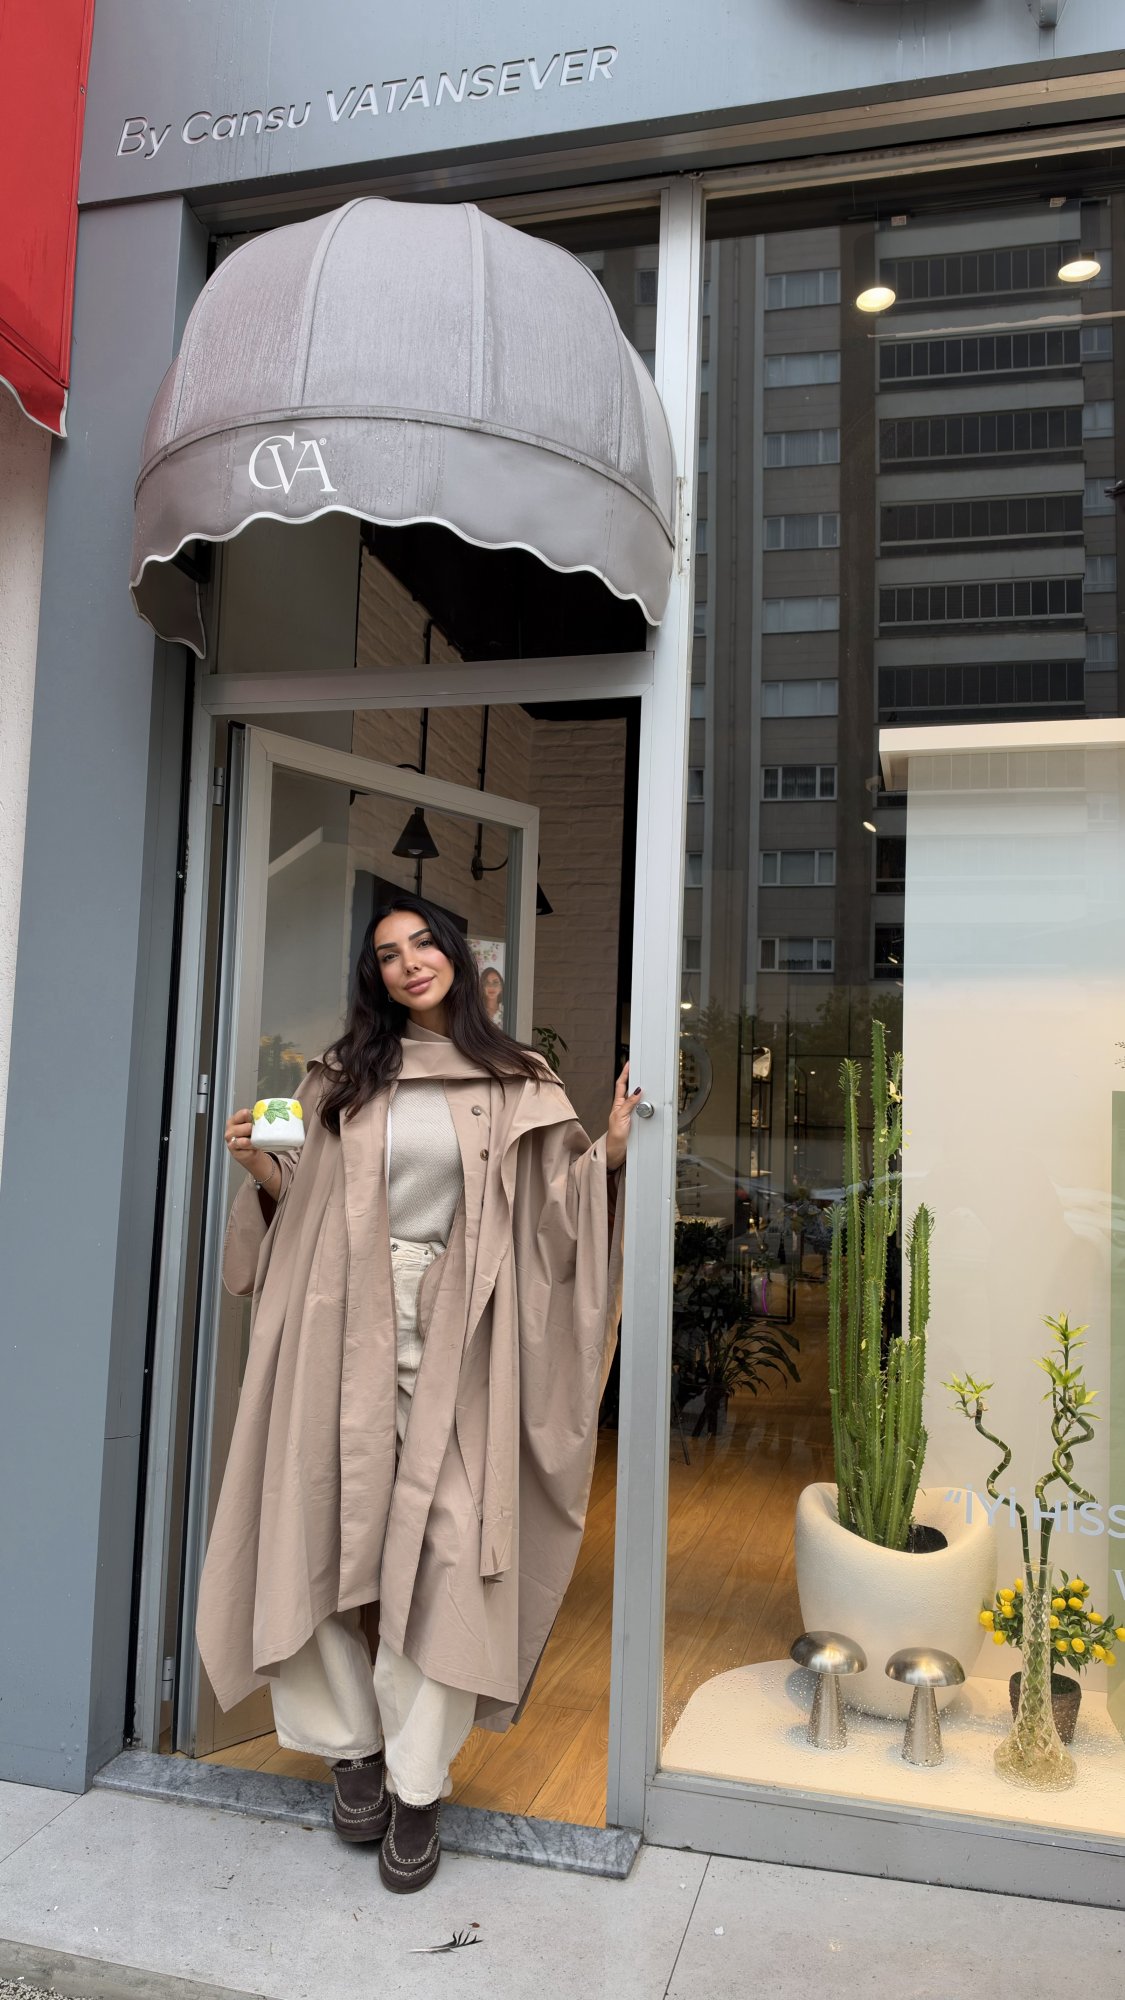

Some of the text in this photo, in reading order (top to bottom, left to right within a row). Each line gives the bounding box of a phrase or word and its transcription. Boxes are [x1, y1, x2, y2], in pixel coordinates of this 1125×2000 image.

[115, 44, 619, 160] By Cansu VATANSEVER
